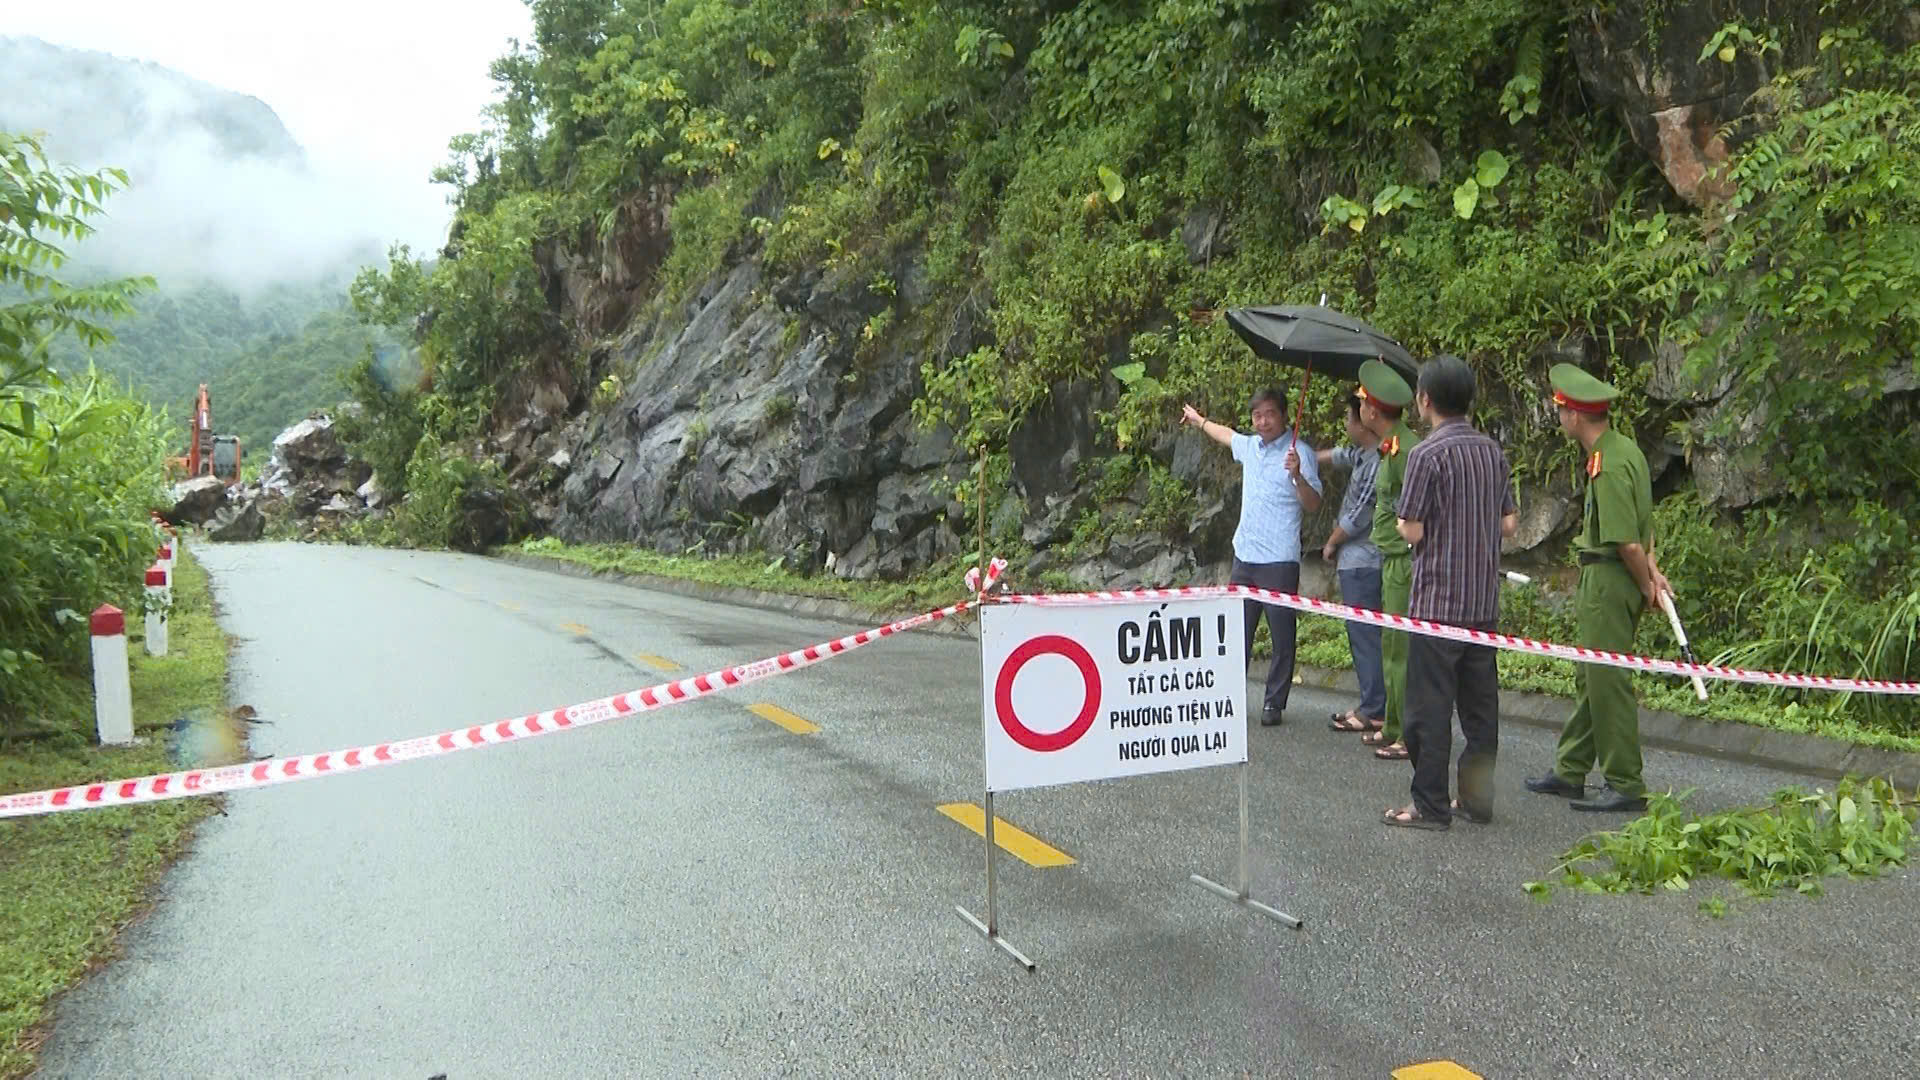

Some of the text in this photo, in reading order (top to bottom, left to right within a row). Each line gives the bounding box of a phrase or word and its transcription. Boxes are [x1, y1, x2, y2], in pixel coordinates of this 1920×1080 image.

[1117, 603, 1226, 664] CẤM !
[1128, 667, 1215, 696] TẤT CẢ CÁC
[1110, 696, 1234, 730] PHƯƠNG TIỆN VÀ
[1119, 731, 1227, 761] NGƯỜI QUA LẠI
